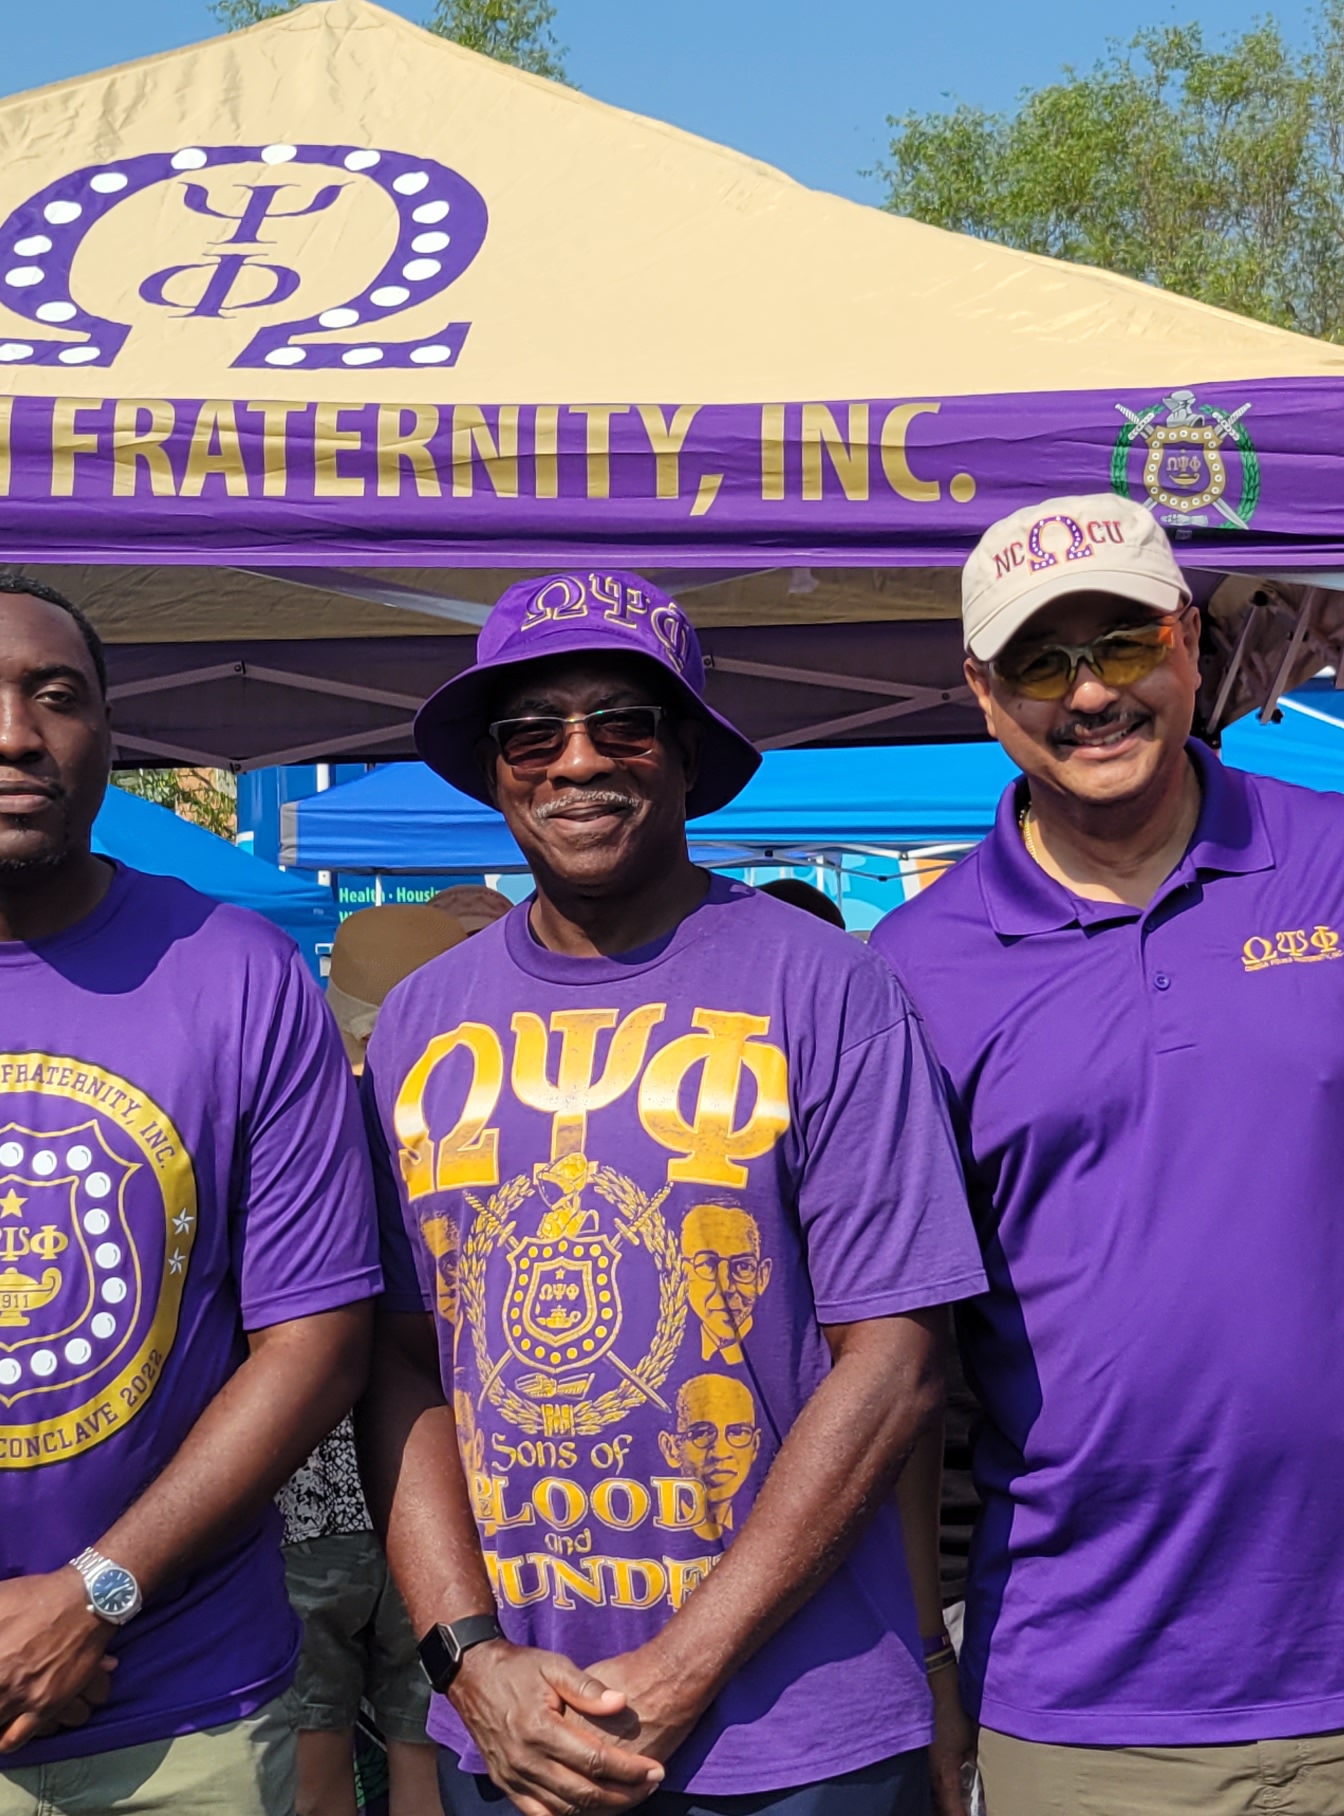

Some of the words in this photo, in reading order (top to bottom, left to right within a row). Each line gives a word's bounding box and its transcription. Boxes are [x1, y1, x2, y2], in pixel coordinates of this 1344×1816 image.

[50, 397, 723, 517] FRATERNITY,
[760, 398, 978, 504] INC.
[992, 541, 1025, 579] NC
[1026, 514, 1095, 575] Ω
[1087, 520, 1125, 544] CU
[1241, 925, 1339, 966] ΩΨΦ
[1, 1062, 145, 1126] FRATERNITY,
[138, 1121, 178, 1171] INC.
[393, 1002, 792, 1203] ΩΨΦ
[491, 1433, 579, 1472] Sons
[591, 1433, 633, 1476] of
[470, 1473, 708, 1532] BLOOD
[543, 1527, 593, 1555] and
